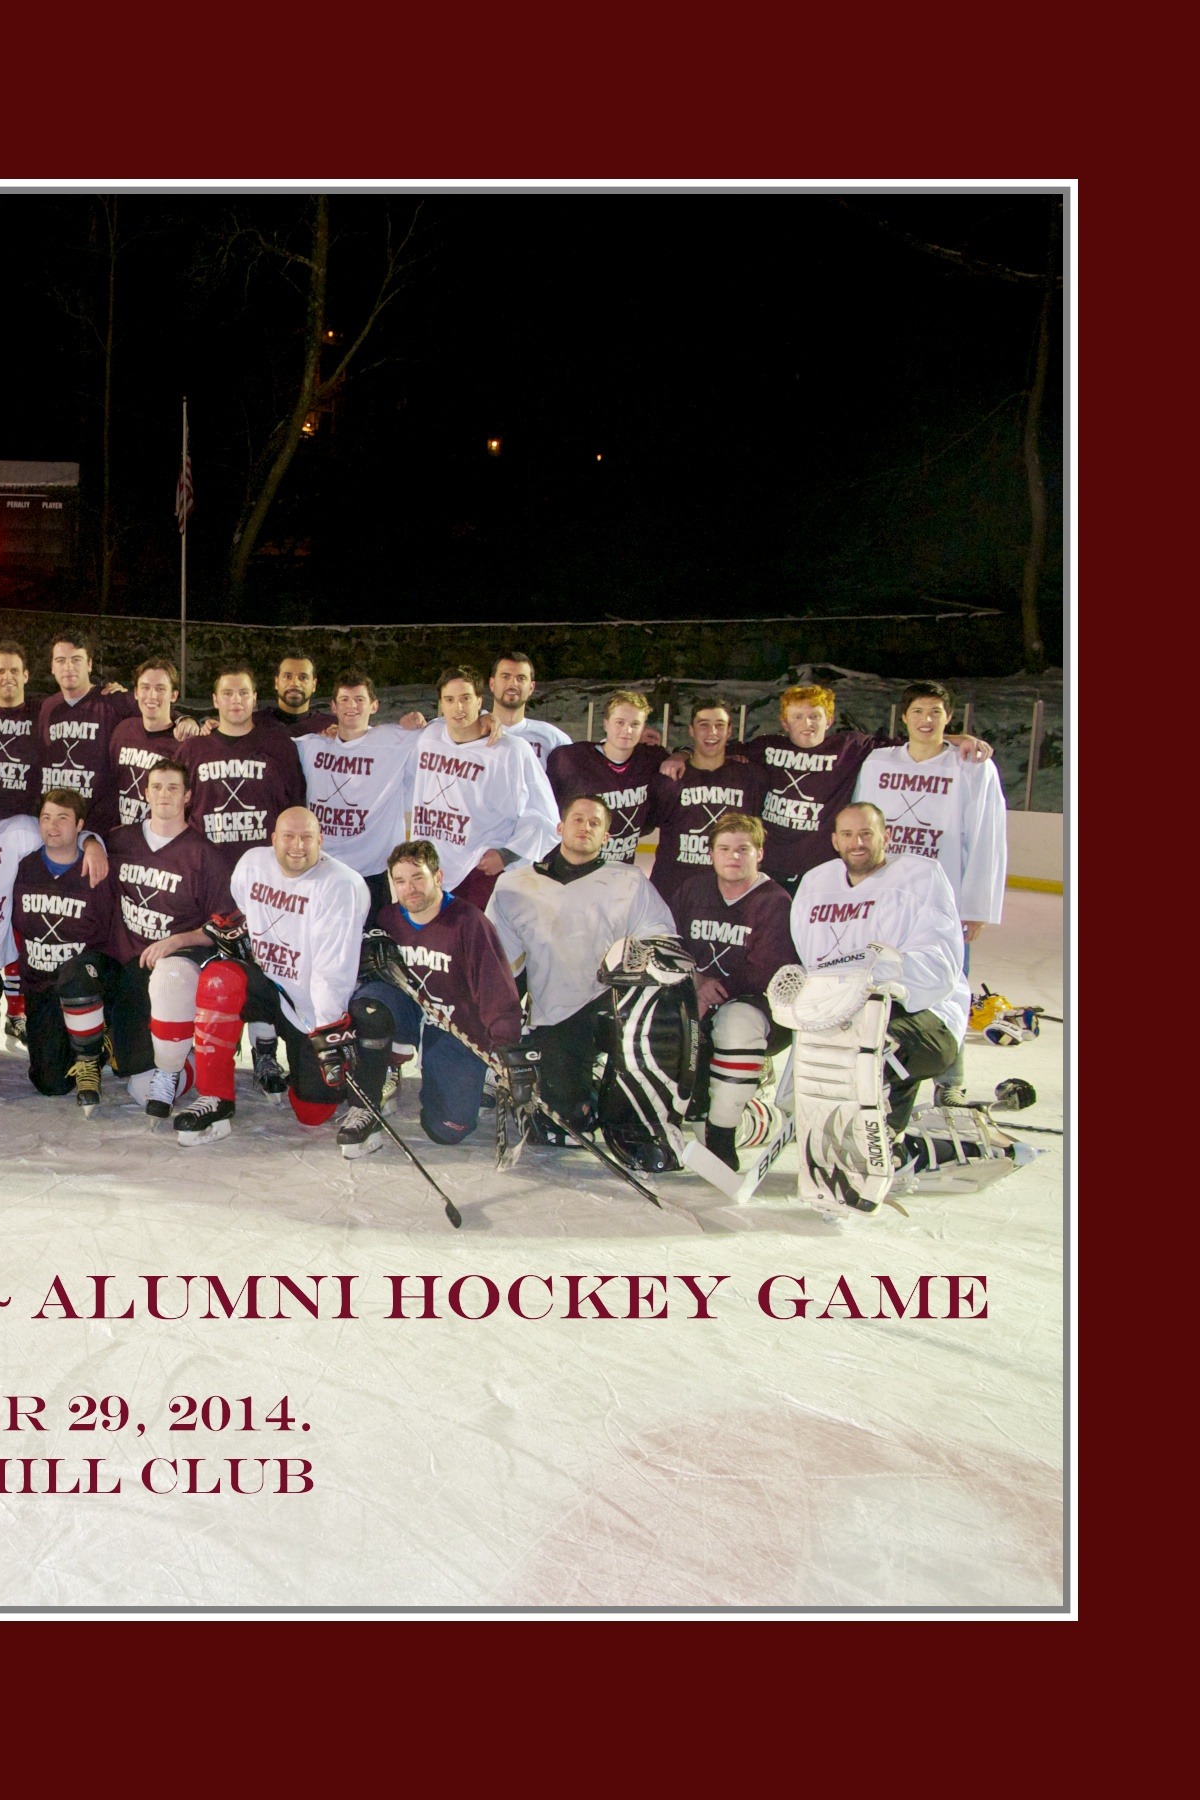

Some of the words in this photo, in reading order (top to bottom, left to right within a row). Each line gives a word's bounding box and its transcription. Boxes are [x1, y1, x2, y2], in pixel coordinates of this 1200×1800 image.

[6, 500, 31, 509] PENALTY
[41, 501, 63, 509] PLAYER
[49, 721, 100, 741] SUMMIT
[314, 752, 375, 776] SUMMIT
[419, 751, 485, 782] SUMMIT
[765, 746, 838, 772] SUMMIT
[198, 759, 267, 782] SUMMIT
[2, 779, 28, 791] TEAM
[879, 772, 953, 795] SUMMIT
[203, 810, 268, 833] HOCKEY
[791, 818, 821, 832] TEAM
[240, 828, 268, 841] TEAM
[679, 834, 710, 854] HOC
[909, 845, 940, 859] TEAM
[119, 863, 183, 894] SUMMIT
[22, 893, 87, 919] SUMMIT
[143, 926, 171, 940] TEAM
[251, 938, 301, 968] OCKEY
[817, 952, 866, 970] SIMMONS
[273, 963, 299, 981] TEAM
[865, 1119, 884, 1168] SIMMONS
